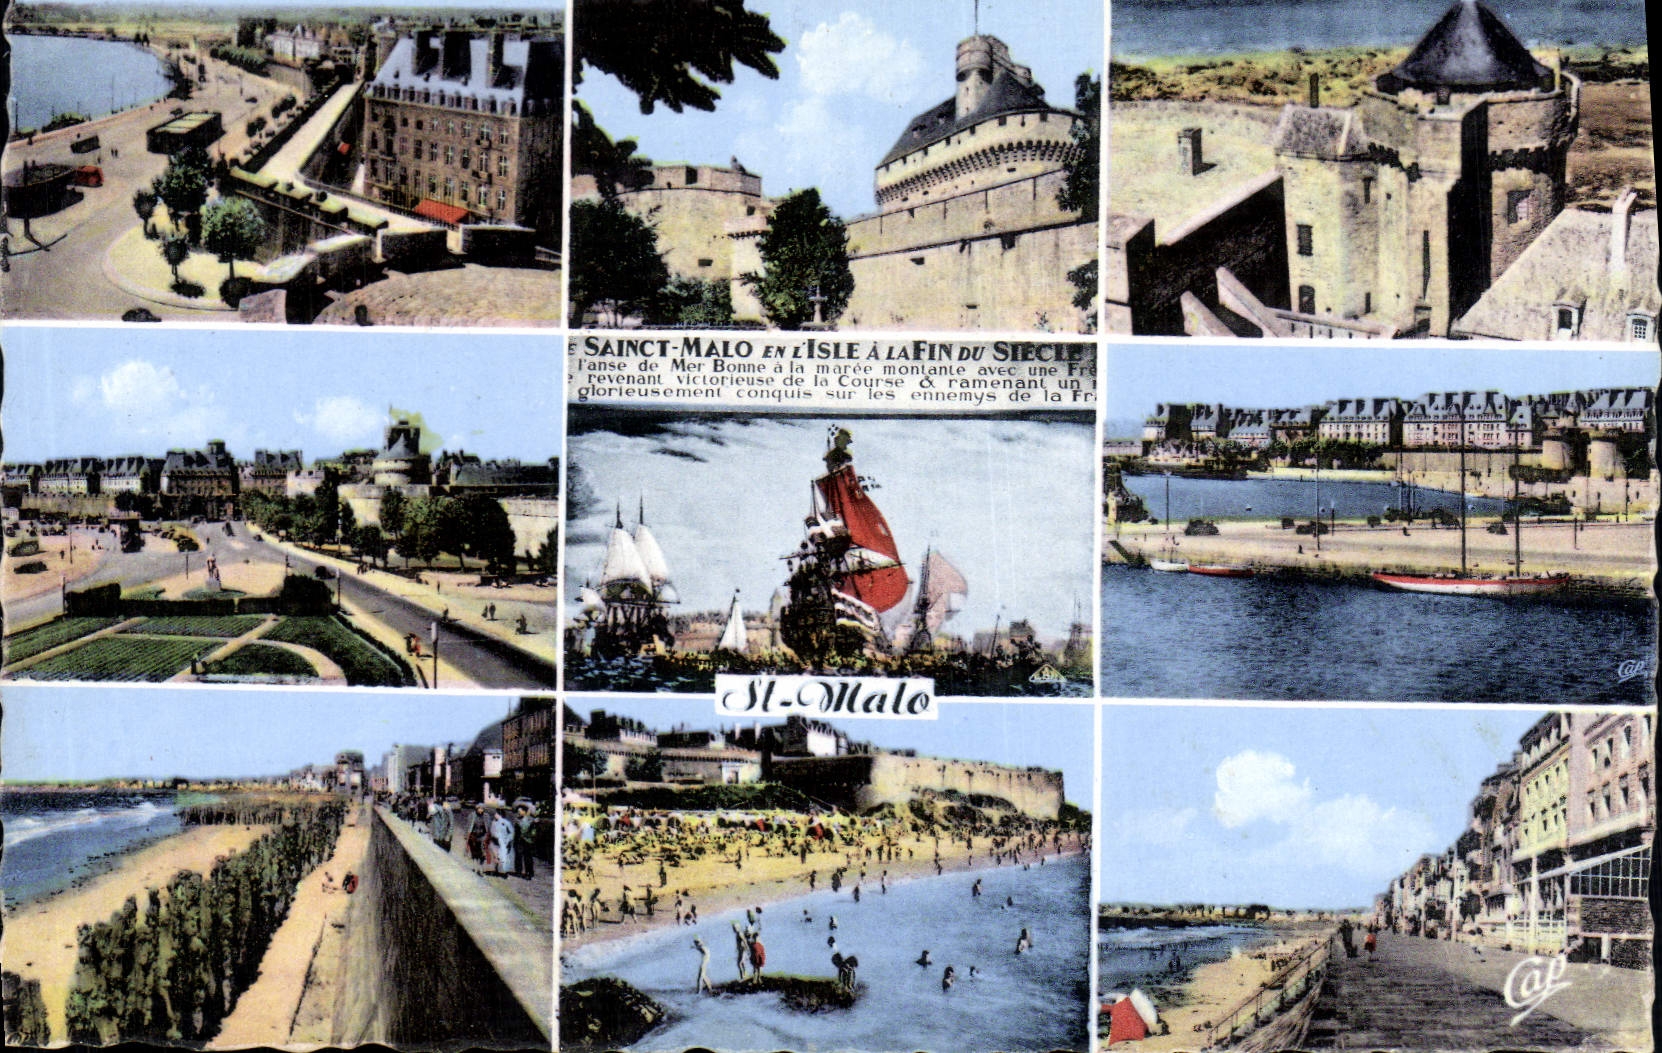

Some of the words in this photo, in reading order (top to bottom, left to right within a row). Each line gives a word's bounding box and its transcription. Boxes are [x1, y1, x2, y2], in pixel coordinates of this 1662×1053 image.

[584, 336, 753, 358] SAINCT-MALO
[762, 345, 786, 358] EN
[866, 341, 880, 360] À
[885, 346, 910, 360] LA
[912, 340, 953, 361] FIN
[957, 346, 986, 361] DU
[578, 358, 627, 372] l'anse
[638, 360, 659, 372] de
[671, 358, 705, 373] Mer
[713, 359, 766, 374] Bonne
[790, 361, 804, 375] la
[816, 363, 873, 375] marée
[883, 364, 966, 376] montante
[977, 366, 1017, 377] avec
[1028, 366, 1058, 377] une
[587, 373, 664, 386] revenant
[676, 373, 775, 387] victorieuse
[782, 375, 805, 387] de
[814, 375, 829, 387] la
[838, 375, 905, 388] Course
[919, 375, 936, 389] &
[948, 378, 1047, 390] ramenant
[1058, 379, 1080, 390] un
[577, 384, 720, 402] glorieusement
[736, 387, 812, 403] conquis
[825, 389, 857, 400] sur
[868, 388, 896, 401] les
[910, 390, 997, 407] ennemys
[1009, 389, 1031, 402] de
[1044, 390, 1061, 402] la
